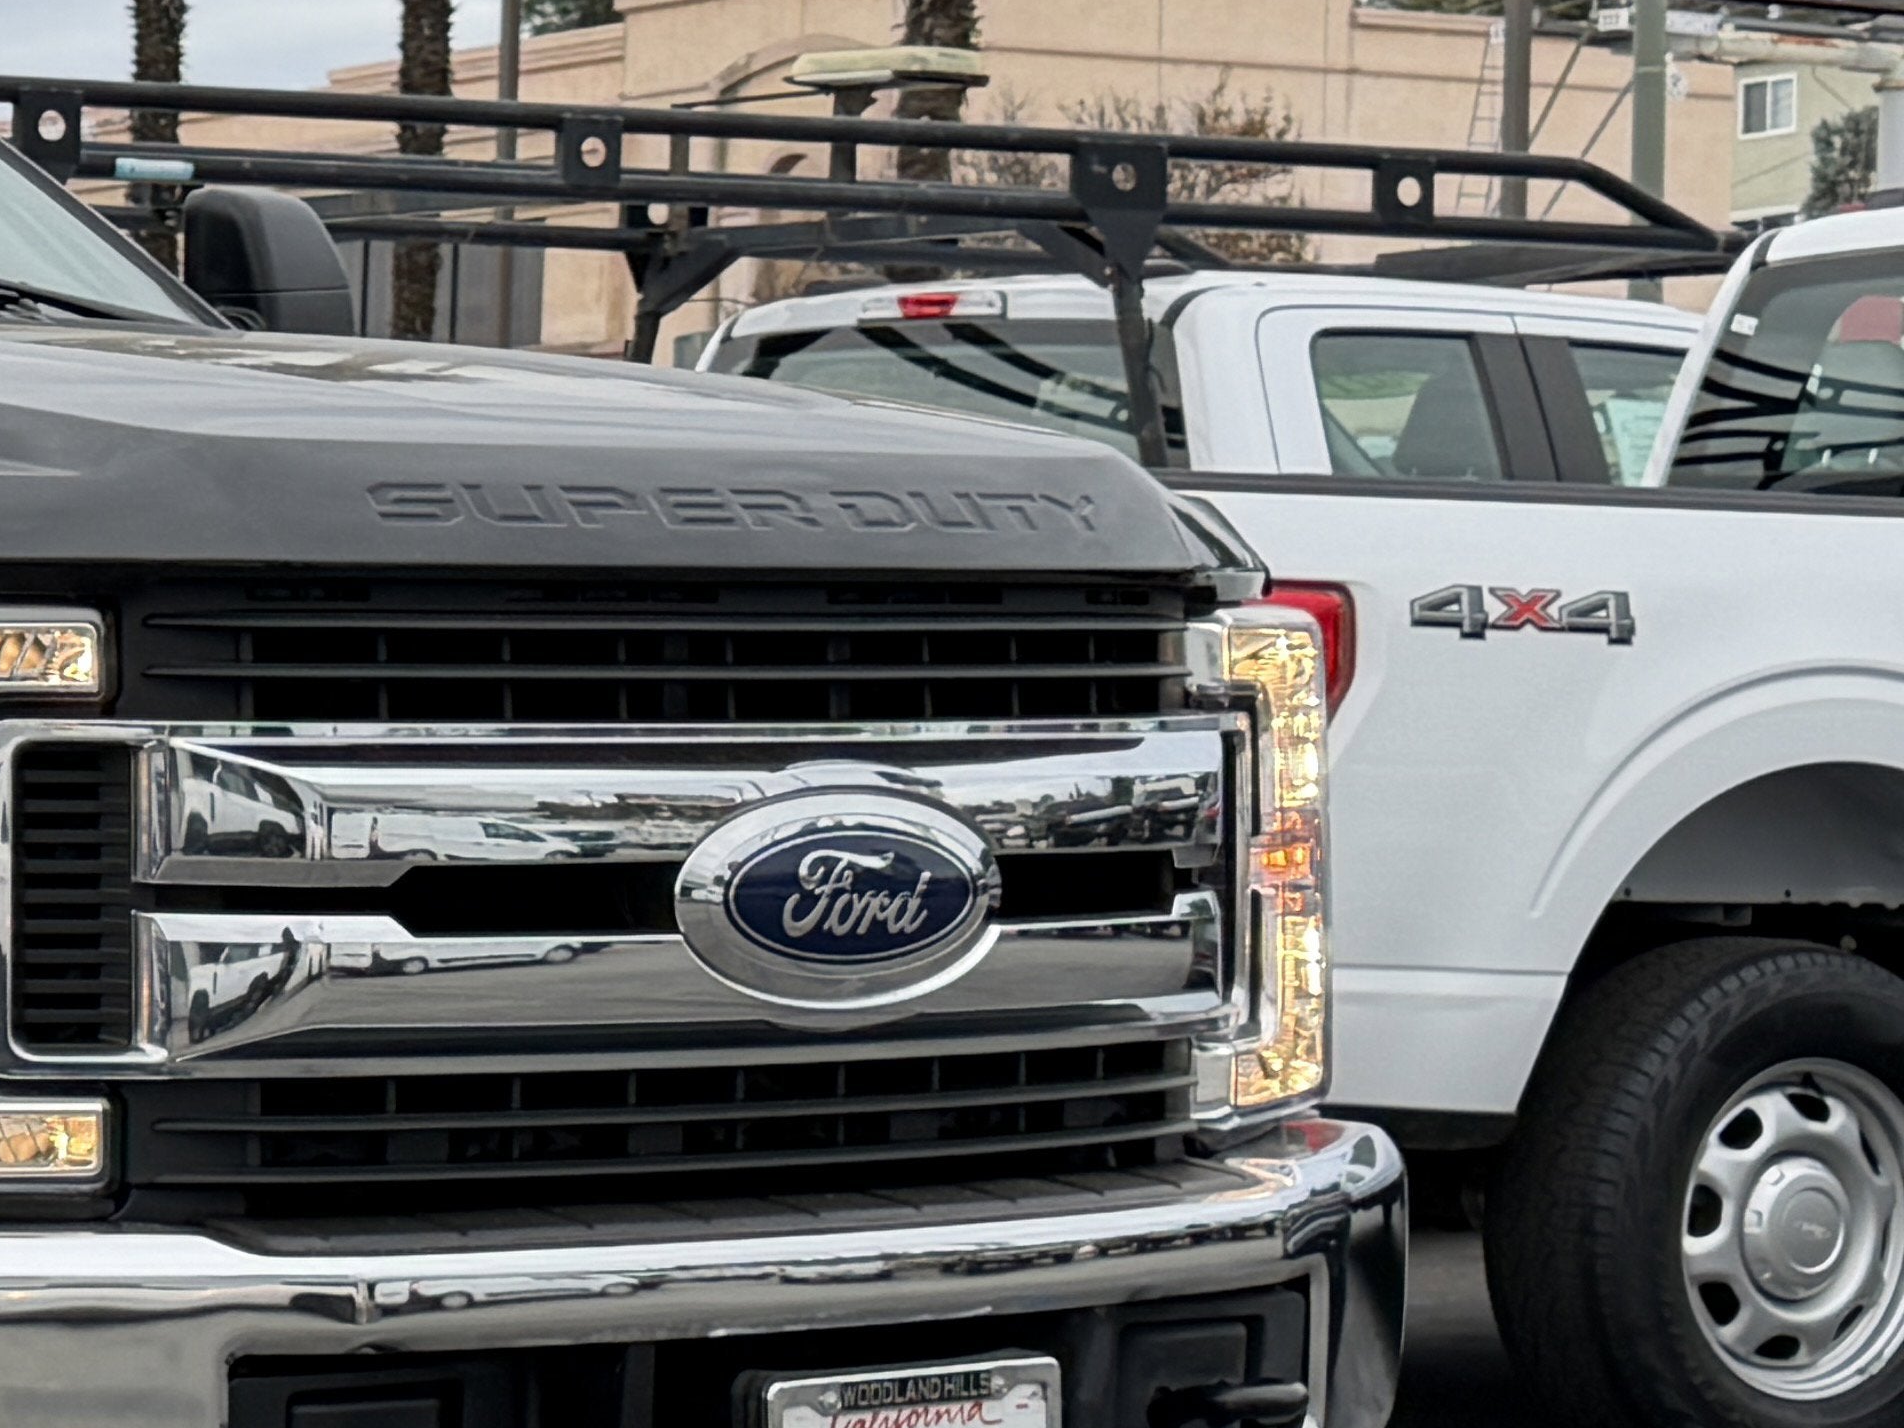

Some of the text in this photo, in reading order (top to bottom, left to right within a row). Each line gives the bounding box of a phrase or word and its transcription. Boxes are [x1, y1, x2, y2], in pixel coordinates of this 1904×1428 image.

[366, 481, 1095, 532] SUPER DUTY
[783, 849, 931, 938] Ford
[843, 1373, 991, 1407] WOODLAND HILLS
